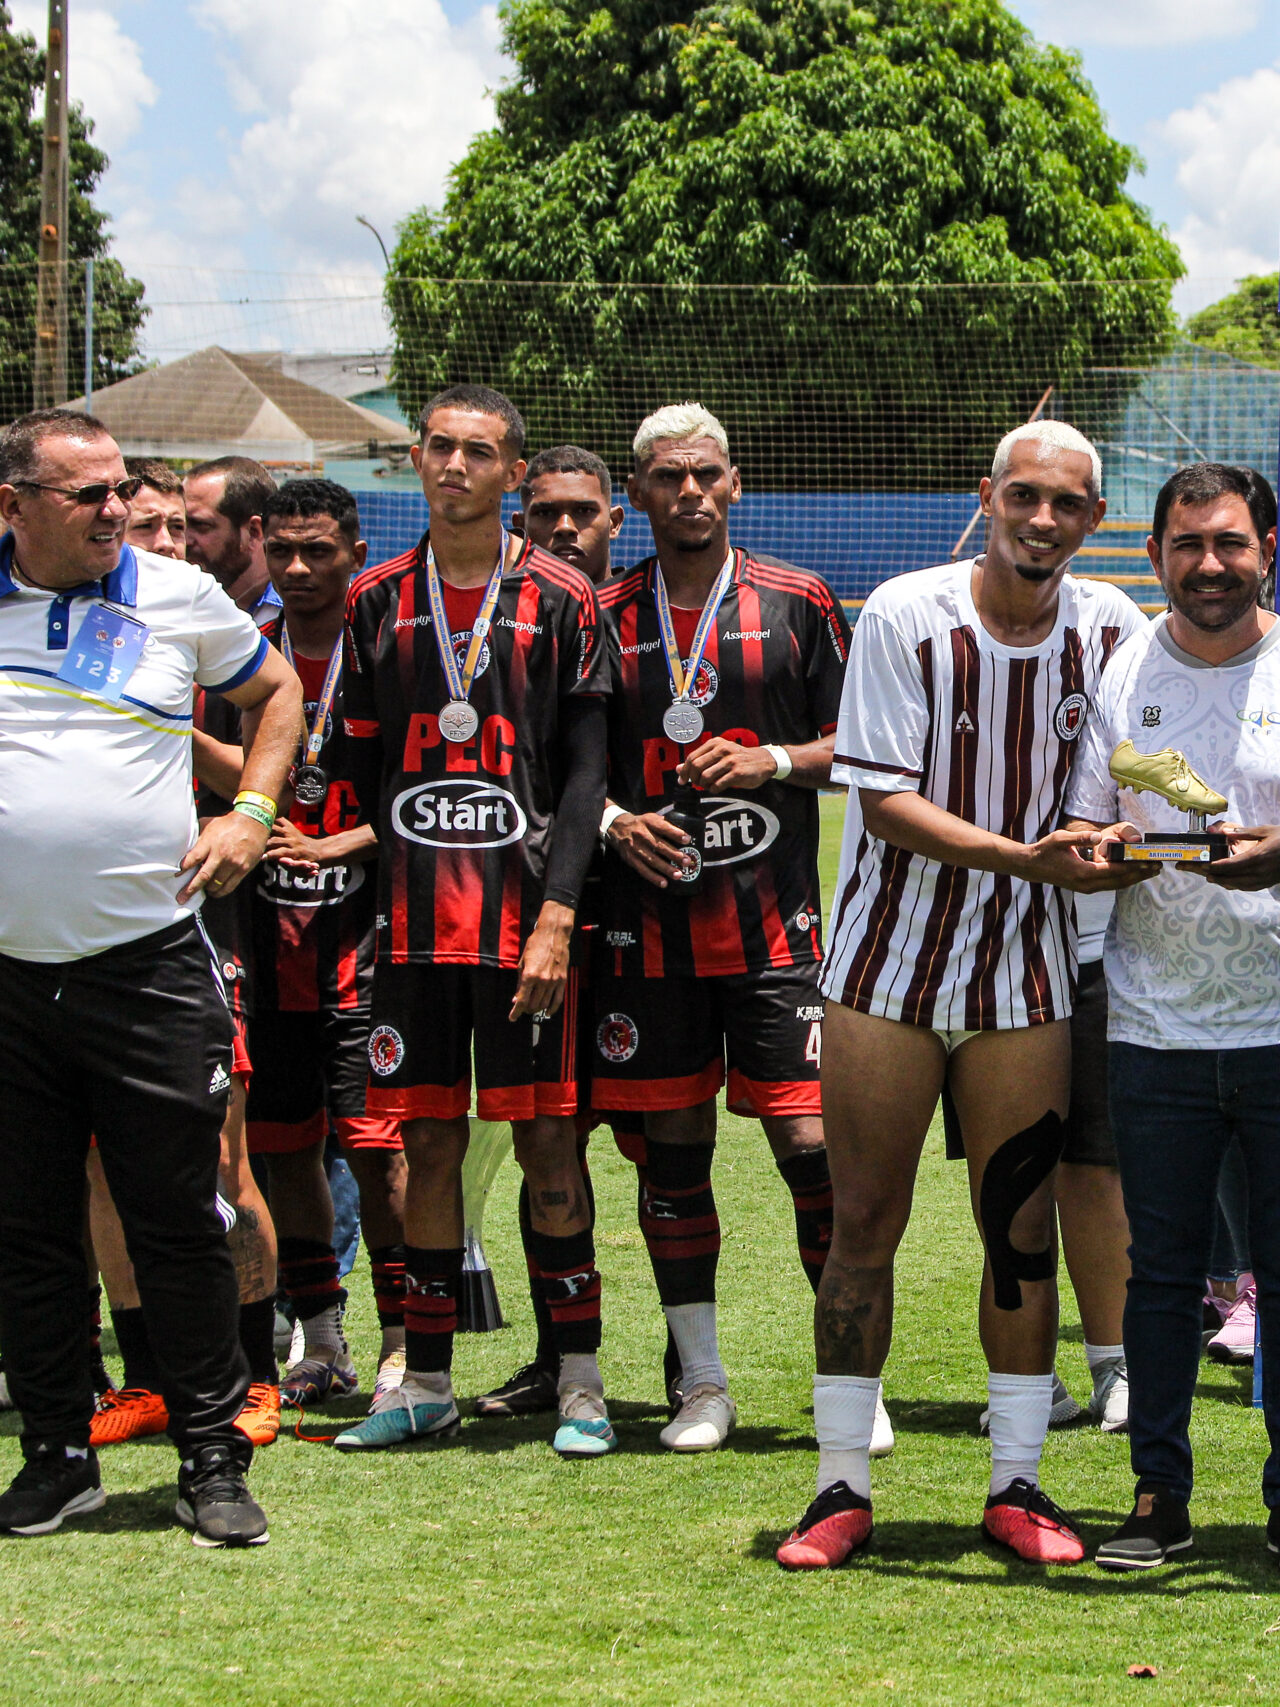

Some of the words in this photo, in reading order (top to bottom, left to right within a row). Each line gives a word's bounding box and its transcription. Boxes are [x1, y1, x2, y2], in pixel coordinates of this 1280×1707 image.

[496, 616, 544, 635] Asseptgel
[722, 628, 771, 641] Asseptgel
[403, 713, 516, 776] PEC
[289, 780, 361, 836] EC
[413, 793, 508, 834] Start
[703, 813, 755, 848] art
[805, 1021, 822, 1069] 4
[209, 1078, 231, 1094] adidas
